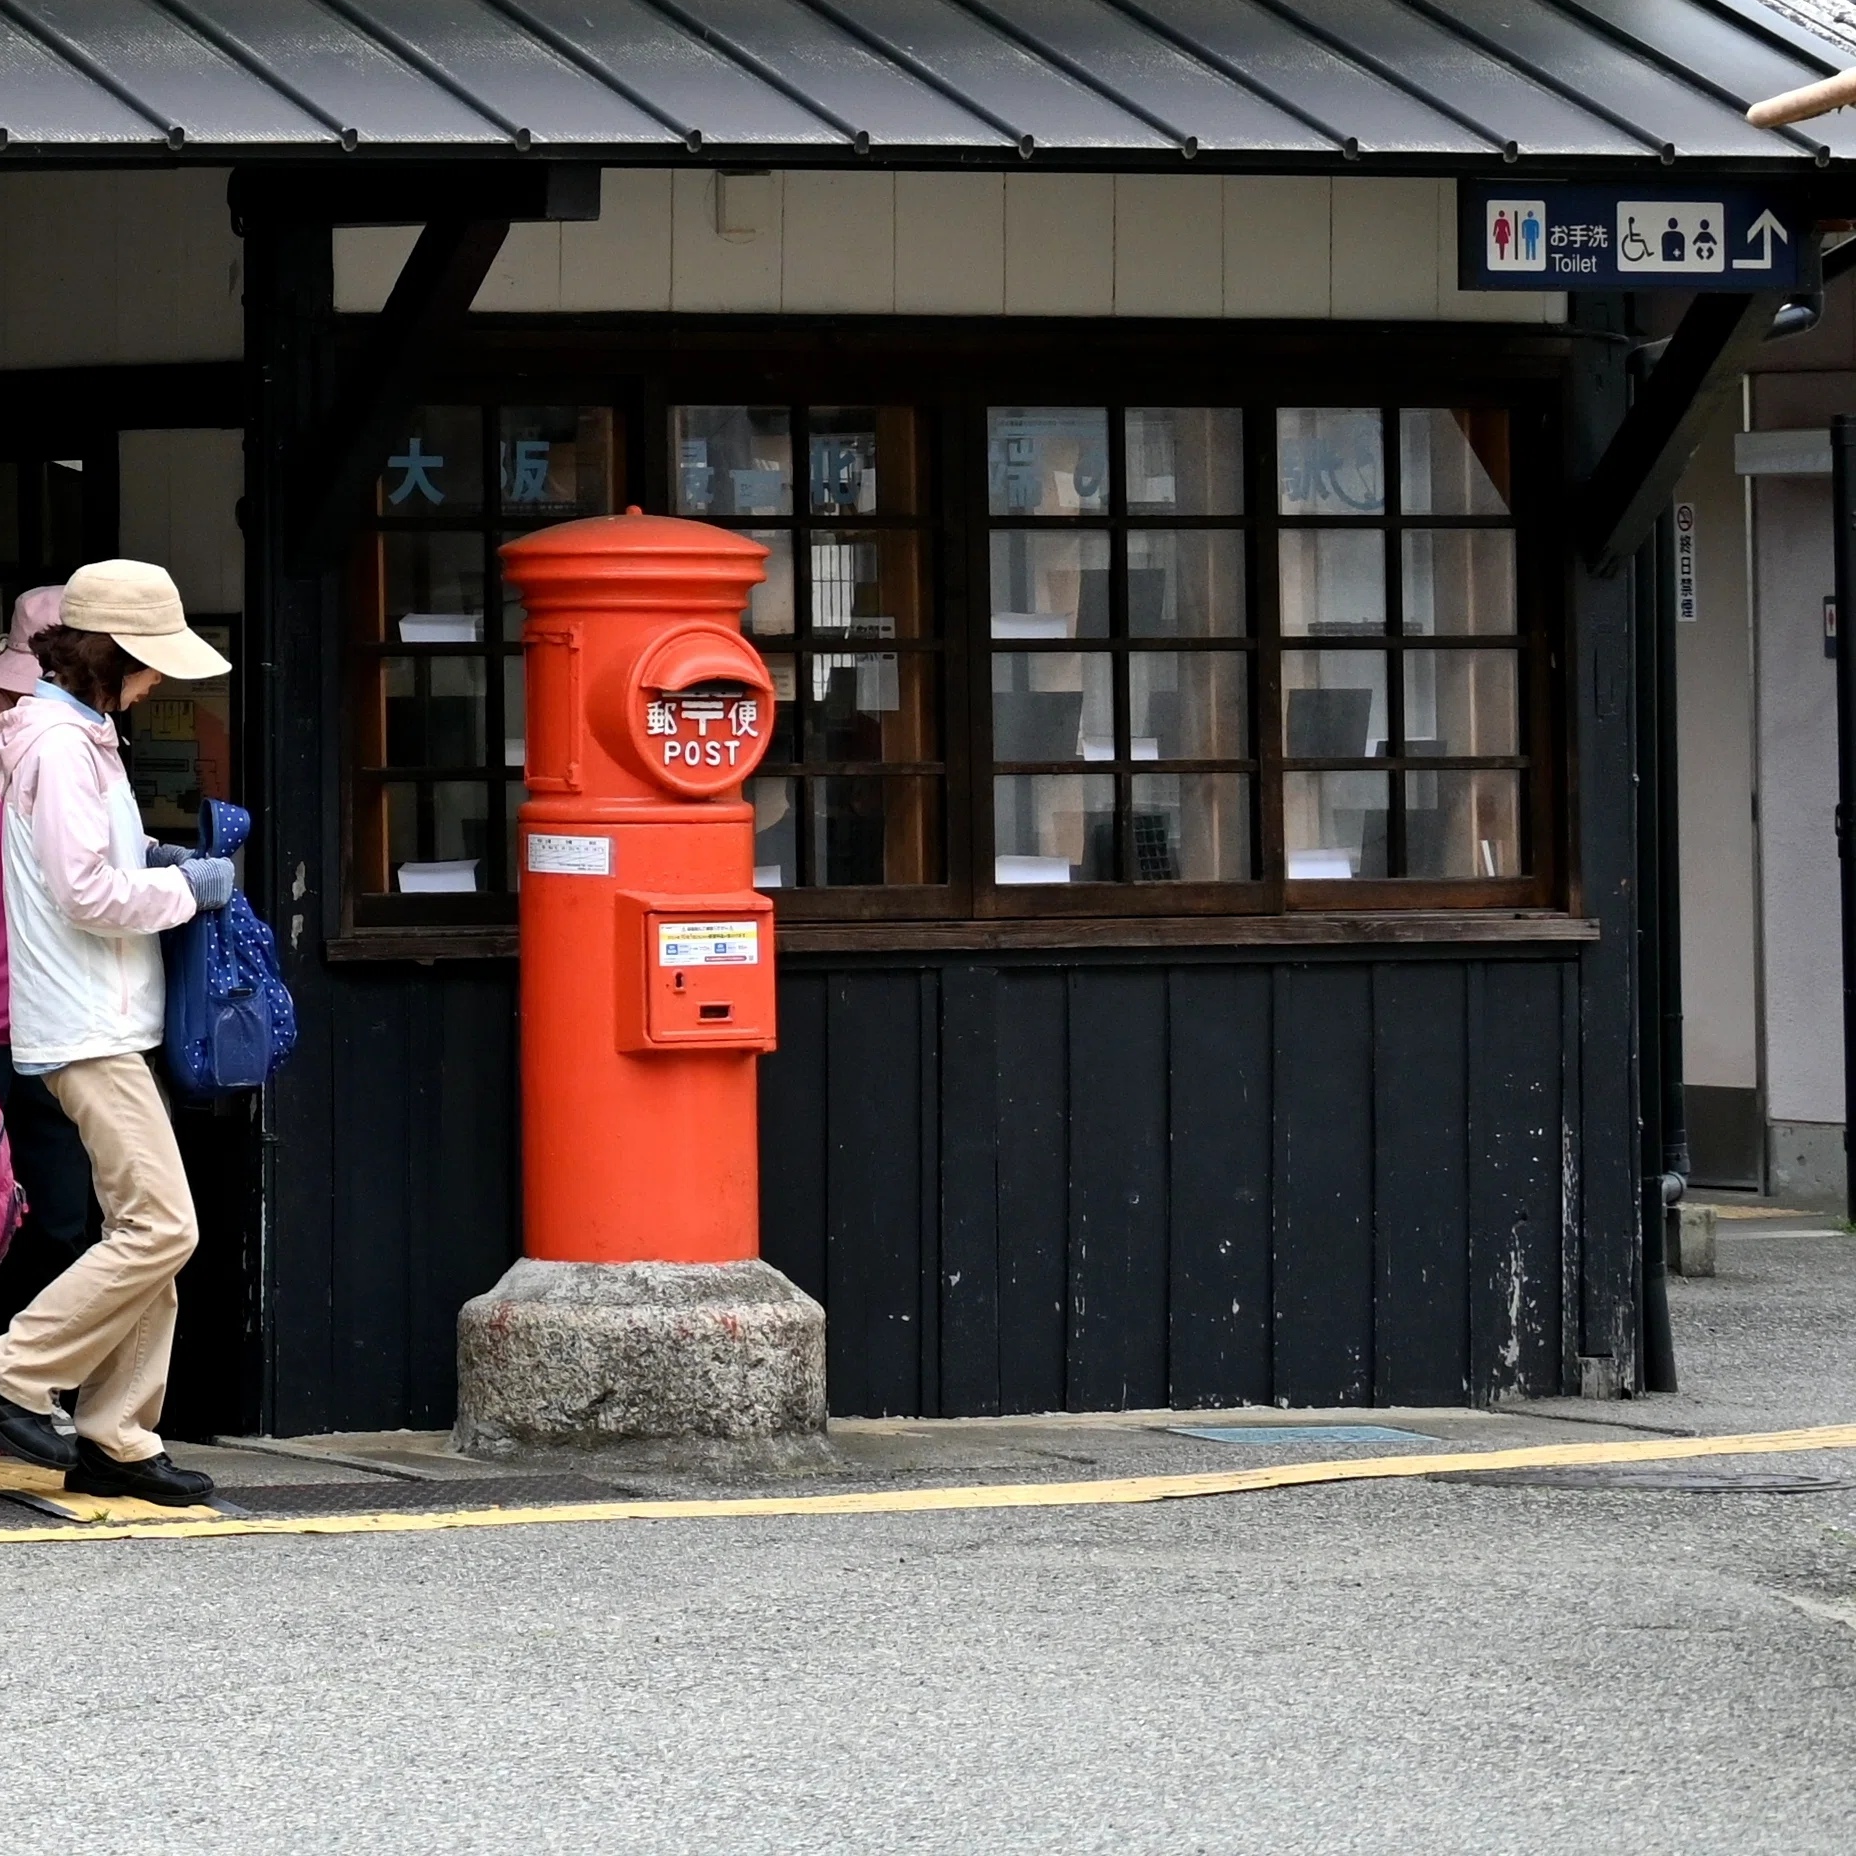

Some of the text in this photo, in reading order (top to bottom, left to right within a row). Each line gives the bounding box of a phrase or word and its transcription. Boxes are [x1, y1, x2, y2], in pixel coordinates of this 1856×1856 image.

[1550, 224, 1608, 248] お手洗
[1550, 253, 1597, 273] Toilet
[1679, 535, 1694, 618] 終日禁煙
[664, 740, 741, 767] POST
